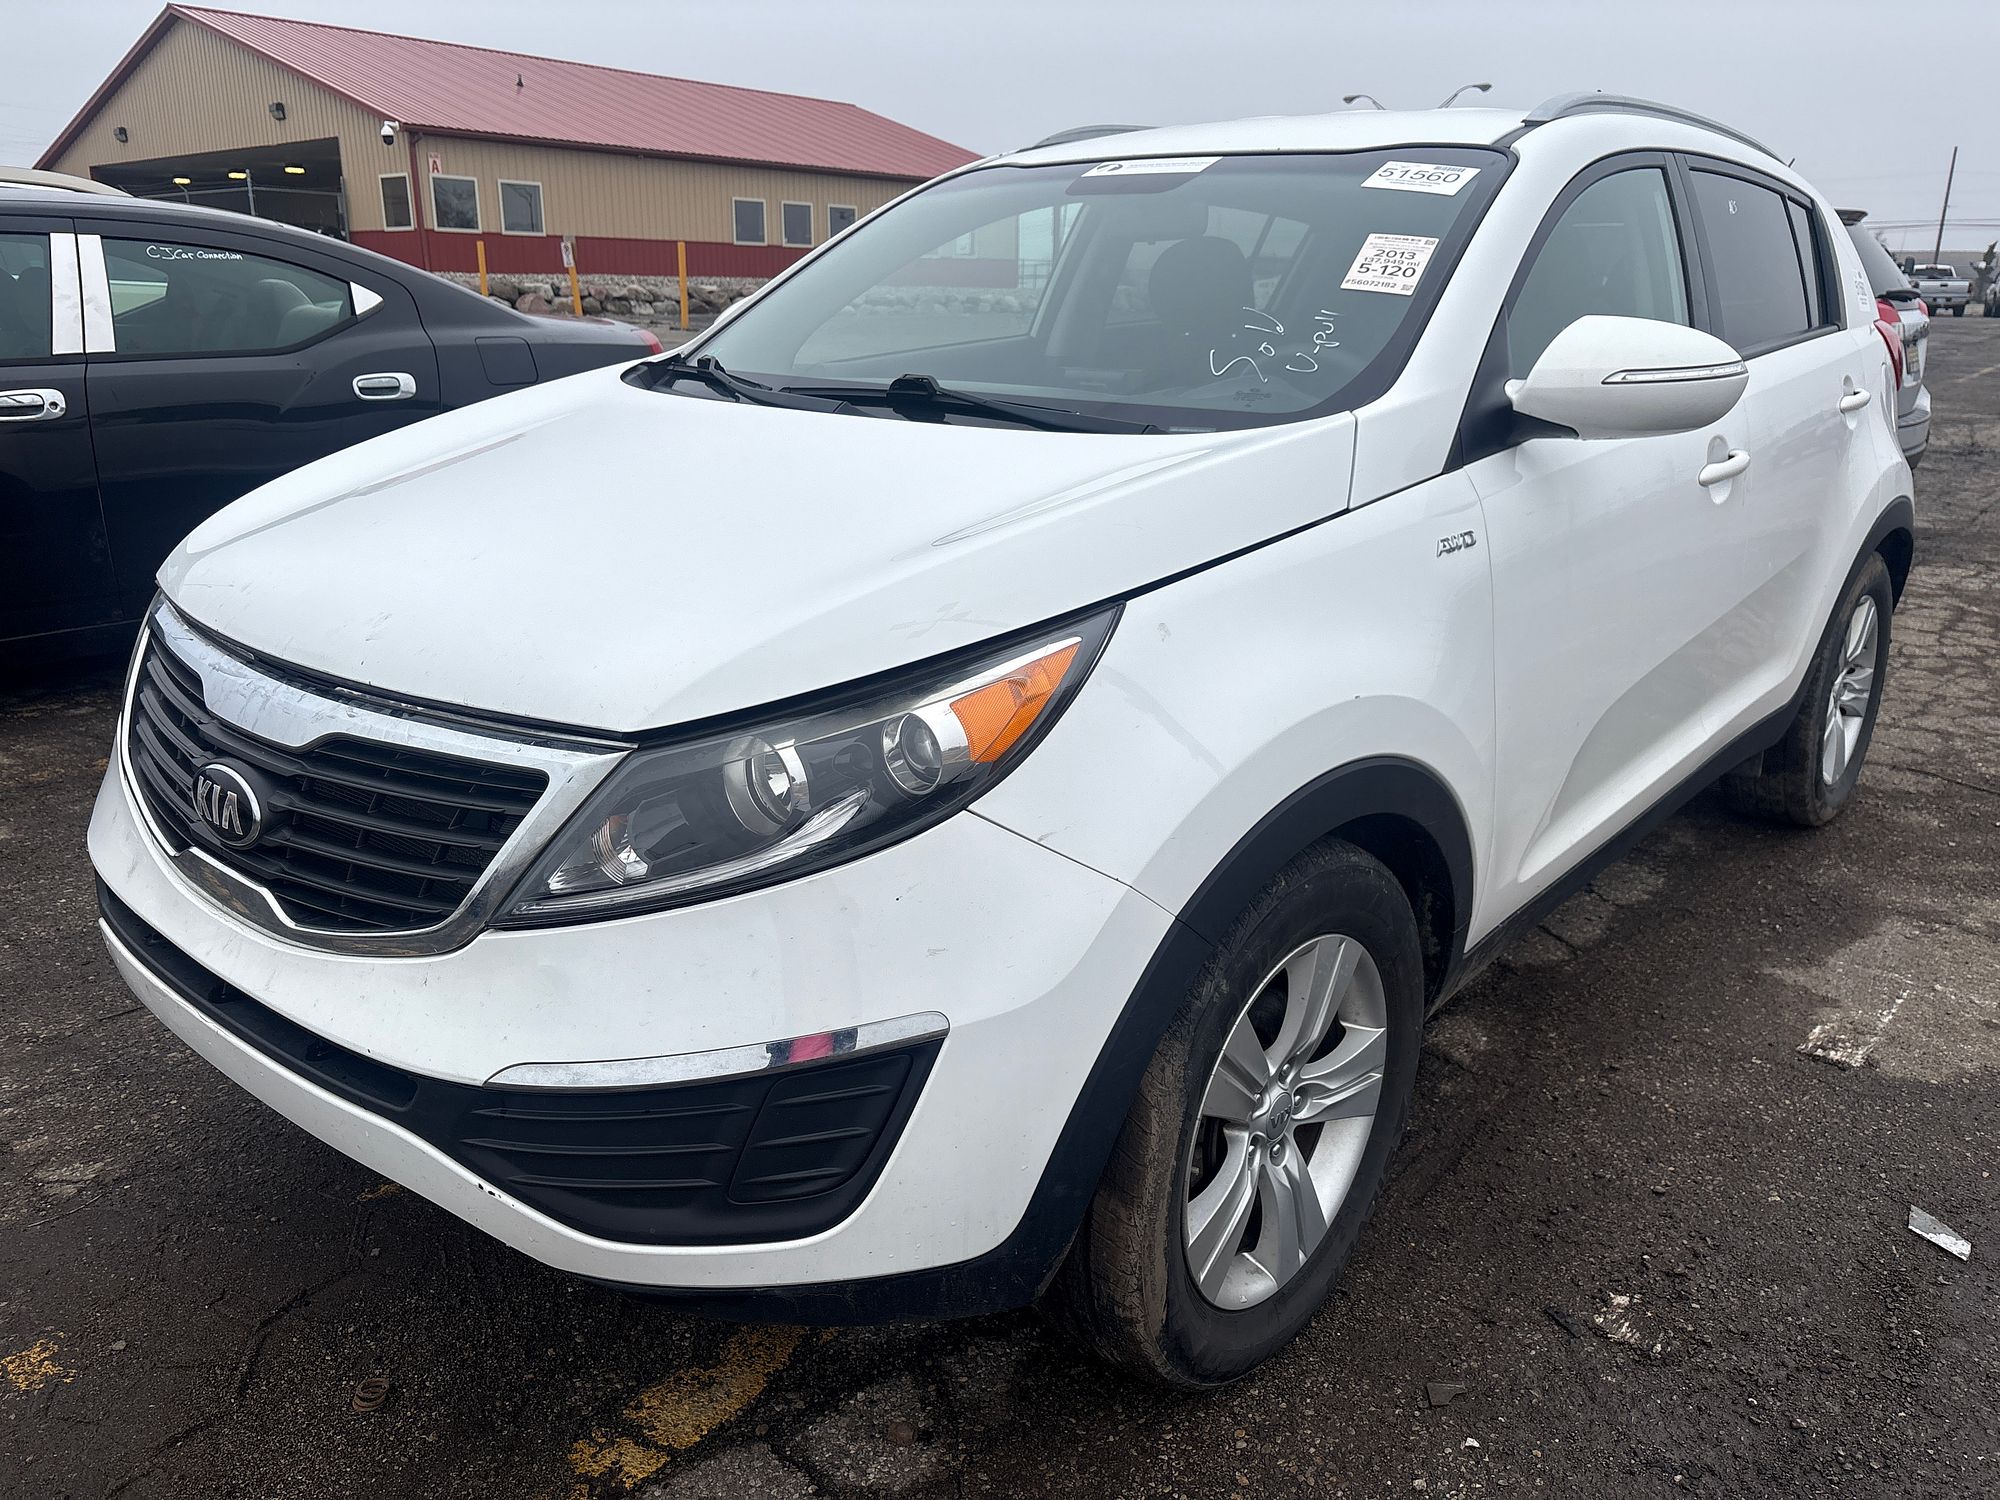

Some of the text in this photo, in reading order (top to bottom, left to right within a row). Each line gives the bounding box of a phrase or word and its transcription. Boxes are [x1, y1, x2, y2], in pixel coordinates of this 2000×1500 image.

[431, 159, 440, 173] A
[1378, 167, 1461, 184] 51560
[174, 249, 194, 260] Car
[196, 250, 243, 260] Connection
[1373, 249, 1417, 261] 2013
[1357, 262, 1417, 278] 5-120
[1344, 279, 1397, 289] #56072182
[1436, 530, 1477, 558] AWD
[196, 775, 244, 836] KIA
